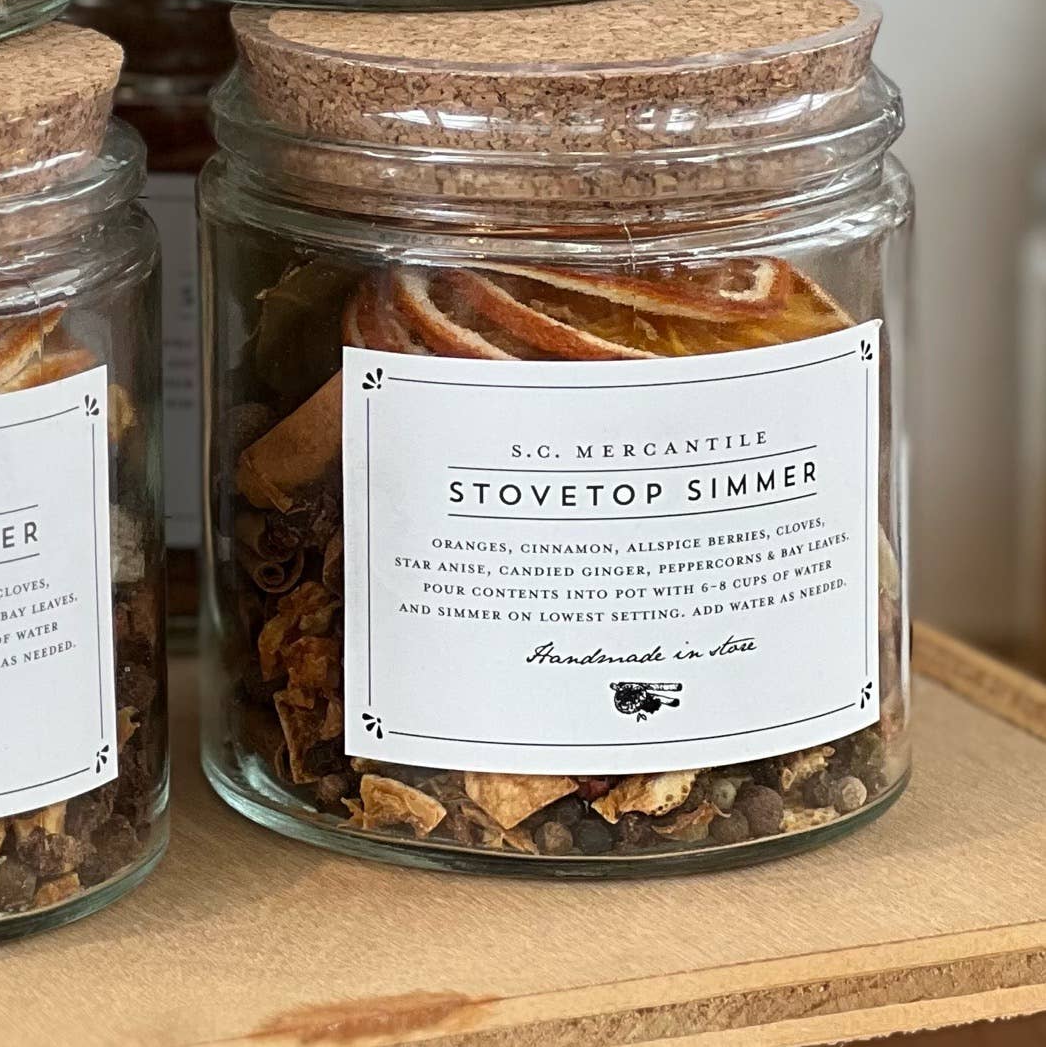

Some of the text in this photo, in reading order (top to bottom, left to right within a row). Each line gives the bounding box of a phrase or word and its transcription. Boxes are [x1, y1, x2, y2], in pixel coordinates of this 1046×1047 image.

[511, 430, 767, 459] S.C. MERCANTILE
[449, 461, 817, 507] STOVETOP SIMMER
[431, 516, 825, 556] ORANGES, CINNAMON, ALLSPICE BERRIES, CLOVES,
[394, 531, 850, 578] STAR ANISE, CANDIED GINGER, PEPPERCORNS & BAY LEAVES.
[423, 582, 466, 596] POUR
[471, 586, 559, 600] CONTENTS
[566, 588, 609, 600] INTO
[615, 587, 648, 600] POT
[652, 584, 695, 598] WITH
[732, 574, 768, 590] CUPS
[772, 569, 790, 583] OF
[794, 559, 832, 577] WATER
[0, 606, 27, 622] BAY
[31, 592, 78, 615] LEAVES.
[398, 602, 431, 615] AND
[437, 606, 502, 621] SIMMER
[507, 610, 532, 622] ON
[539, 611, 605, 623] LOWEST
[611, 608, 686, 622] SETTING.
[691, 603, 724, 617] ADD
[729, 595, 775, 612] WATER
[779, 591, 795, 604] AS
[15, 621, 58, 641] WATER
[0, 655, 18, 668] AS
[23, 640, 76, 663] NEEDED.
[525, 634, 758, 666] Handmade in store
